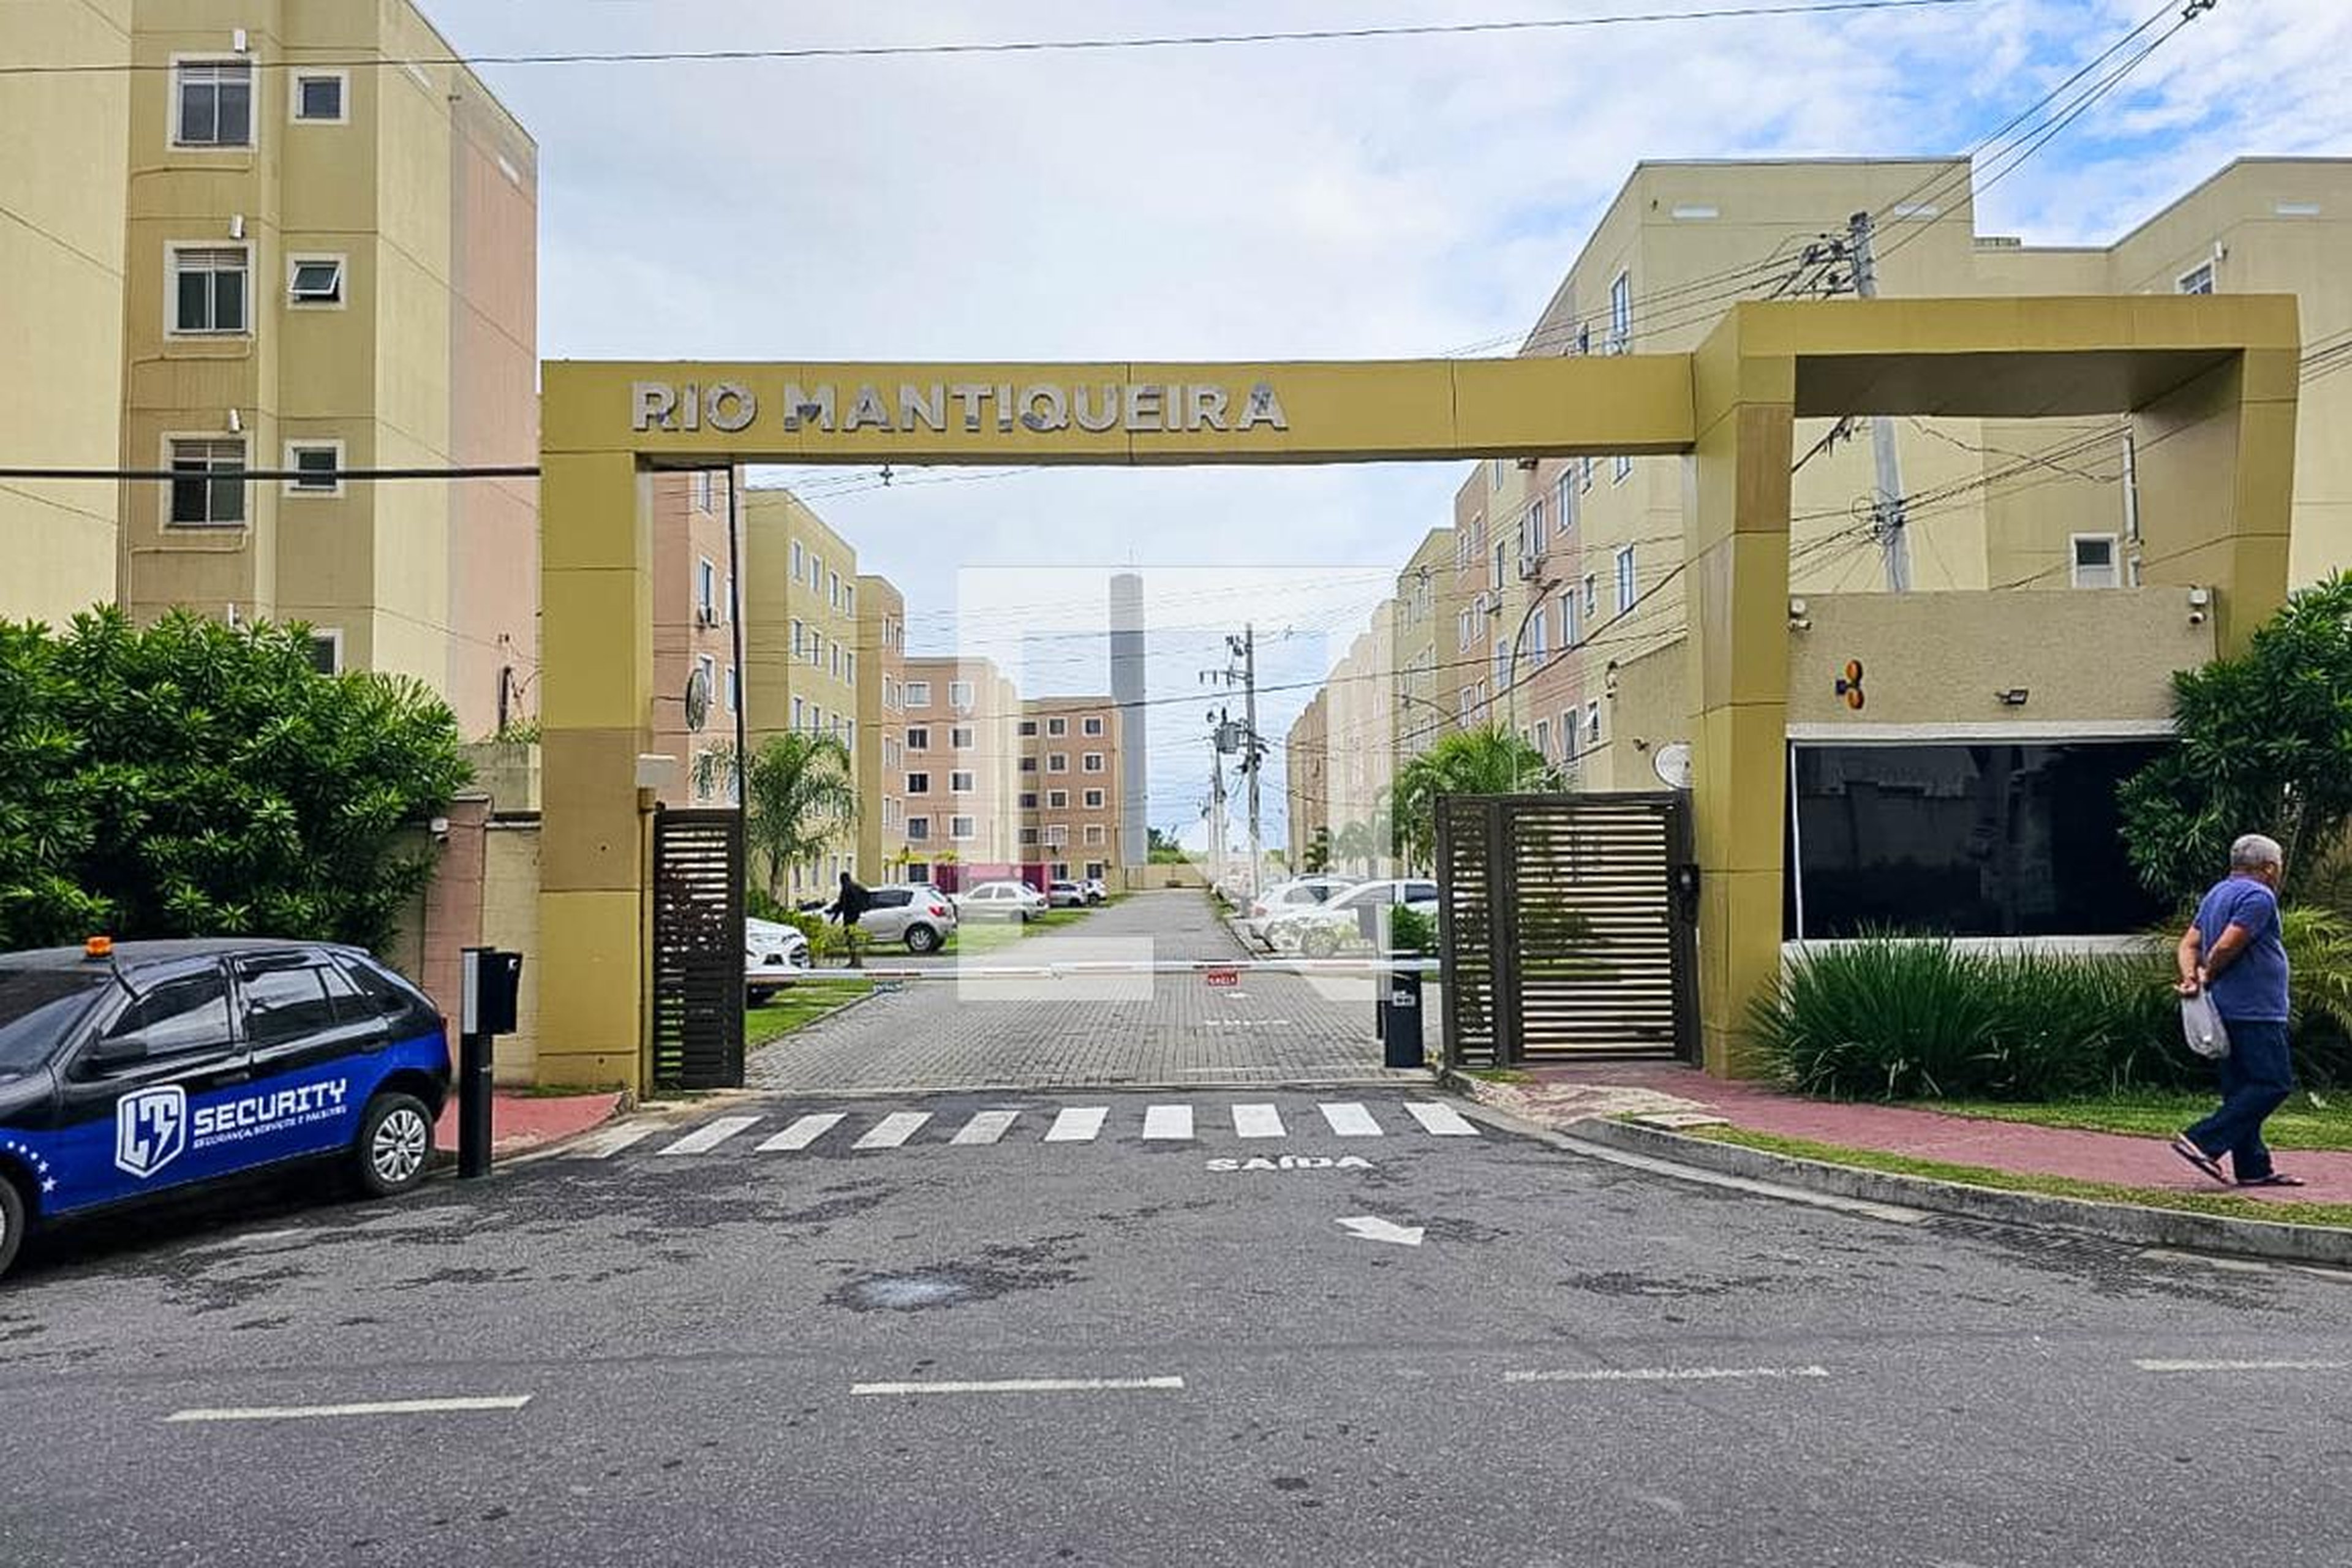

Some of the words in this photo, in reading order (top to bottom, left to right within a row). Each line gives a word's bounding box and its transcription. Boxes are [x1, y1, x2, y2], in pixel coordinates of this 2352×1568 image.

[633, 382, 757, 432] RIO
[783, 382, 1289, 431] MANTIQUEIRA
[194, 1078, 347, 1136] SECURITY
